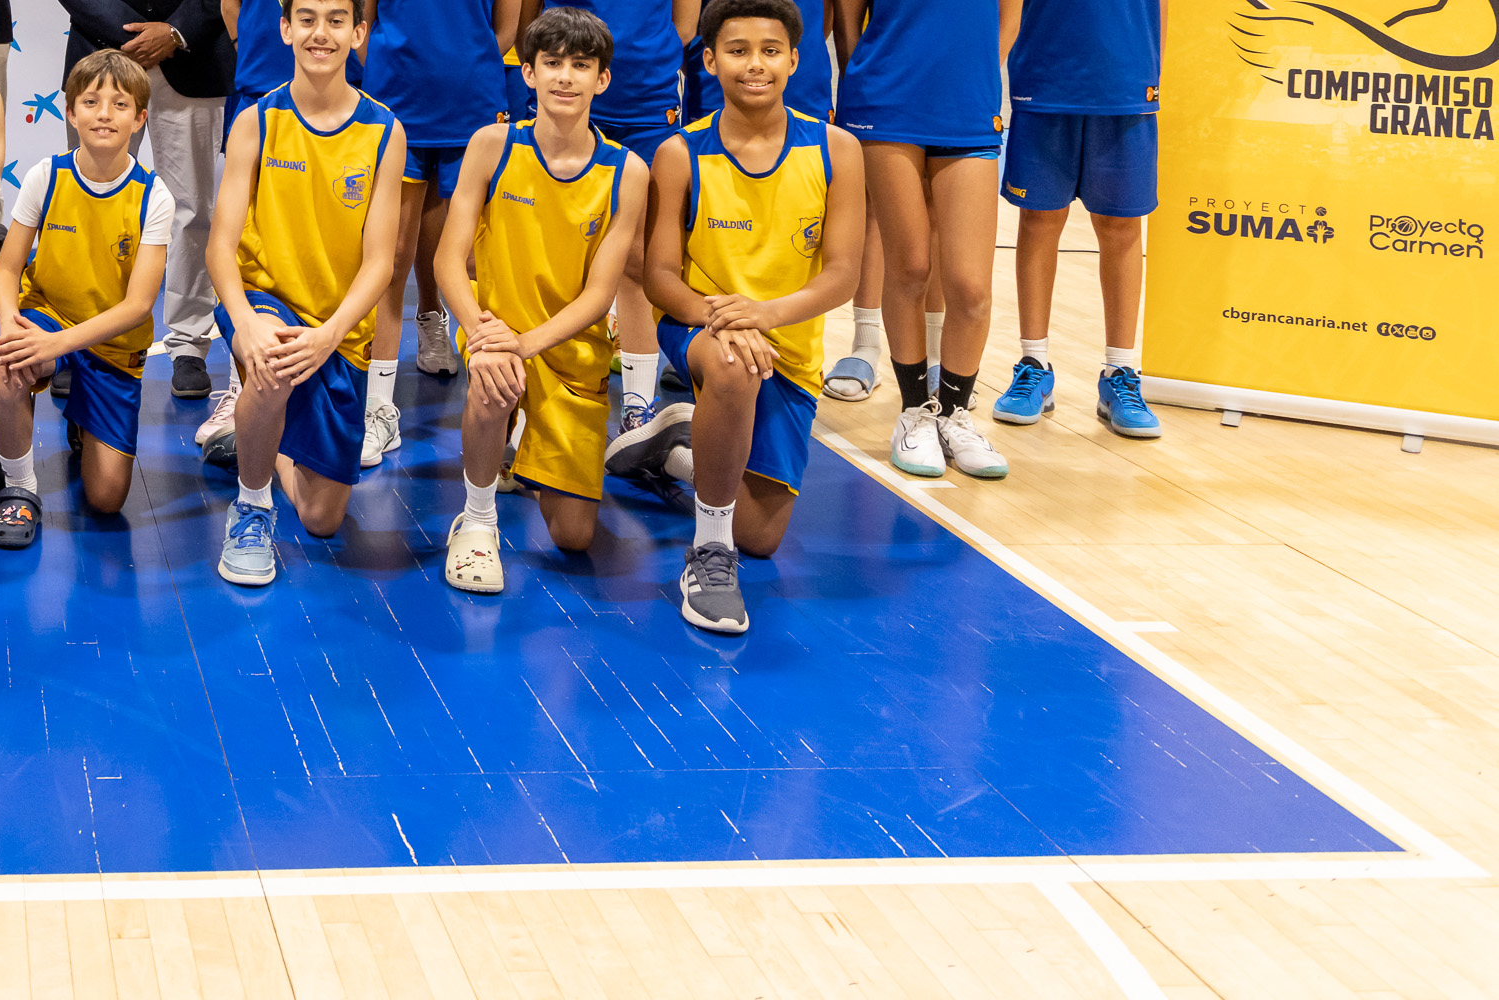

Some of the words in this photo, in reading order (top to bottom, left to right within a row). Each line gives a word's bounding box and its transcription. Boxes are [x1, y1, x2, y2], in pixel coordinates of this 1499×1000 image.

[1287, 68, 1494, 109] COMPROMISO
[1369, 103, 1495, 141] GRANCA
[266, 157, 306, 172] SPALDING
[502, 191, 535, 206] SPALDING
[47, 223, 77, 234] SPALDING
[708, 218, 753, 231] SPALDING
[1369, 214, 1485, 241] Proyecto
[1369, 231, 1484, 259] Carmen
[1222, 306, 1368, 333] cbgrancanaria.net
